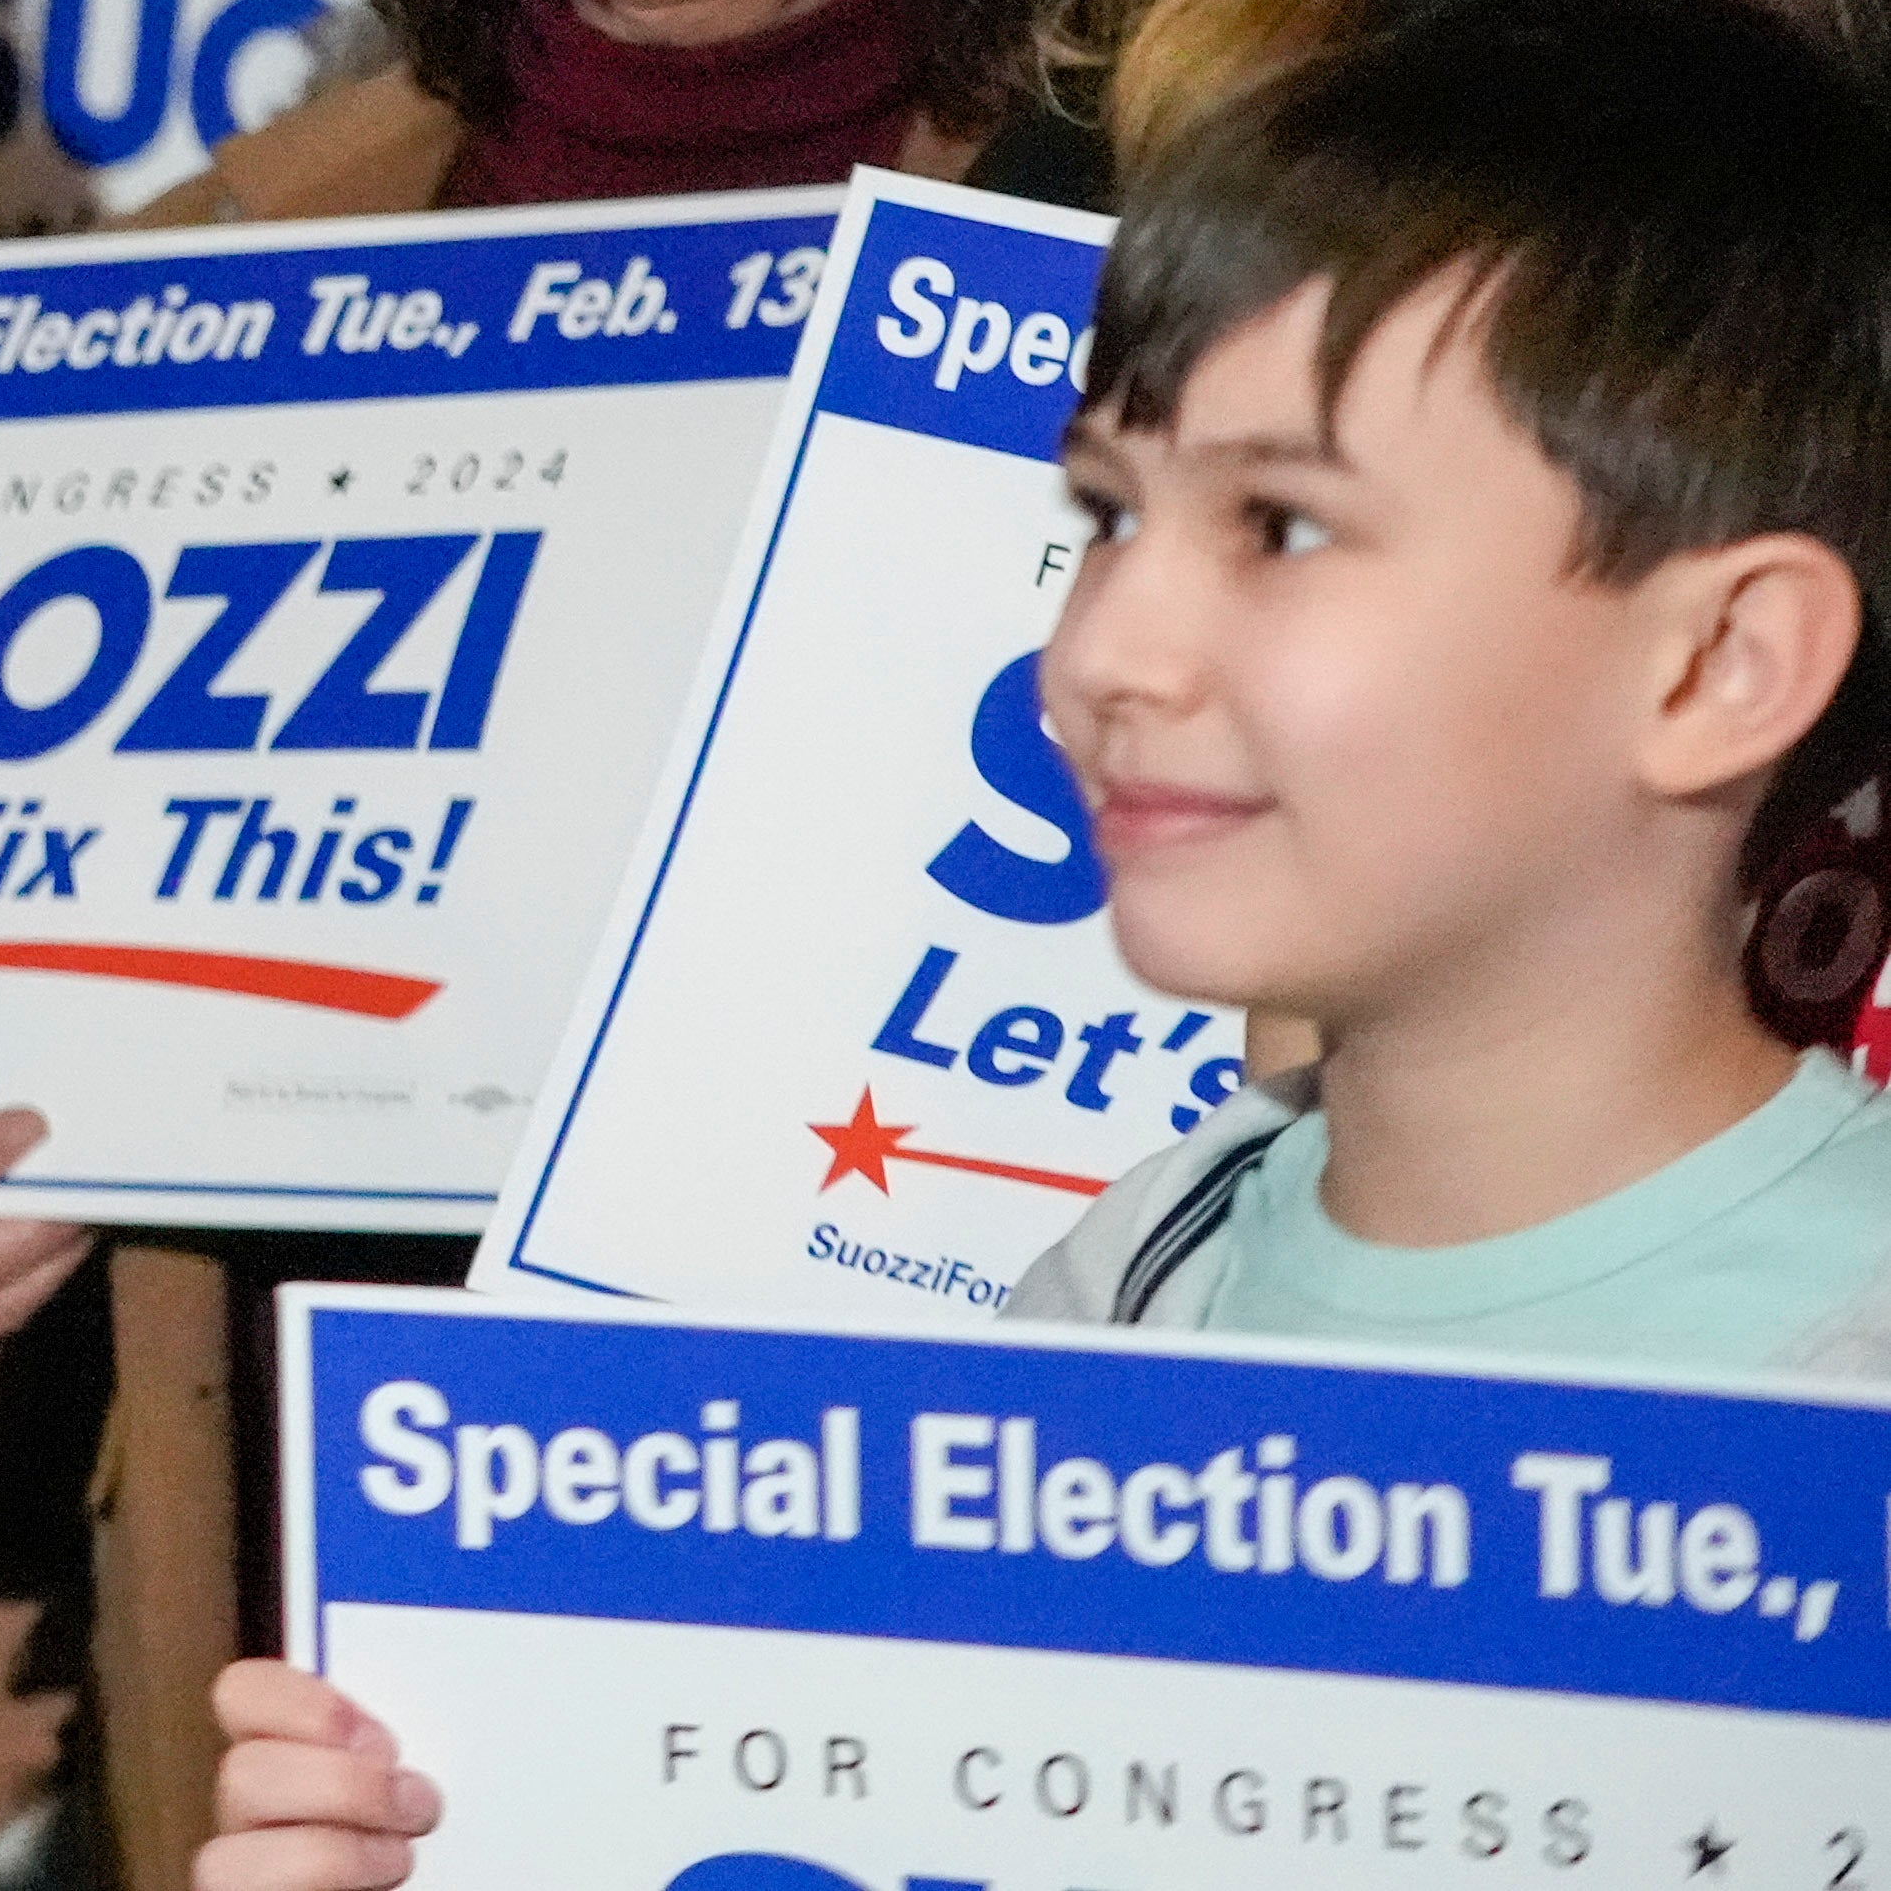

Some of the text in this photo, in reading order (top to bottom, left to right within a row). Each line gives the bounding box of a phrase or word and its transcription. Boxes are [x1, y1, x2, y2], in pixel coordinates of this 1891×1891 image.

[302, 274, 480, 358] Tue.,
[508, 262, 678, 342] Feb.
[725, 247, 825, 329] 13
[403, 449, 571, 496] 2024
[154, 796, 478, 903] This!
[358, 1379, 1842, 1644] Special Election Tue.,
[662, 1723, 871, 1799] FOR
[952, 1746, 1594, 1867] CONGRESS
